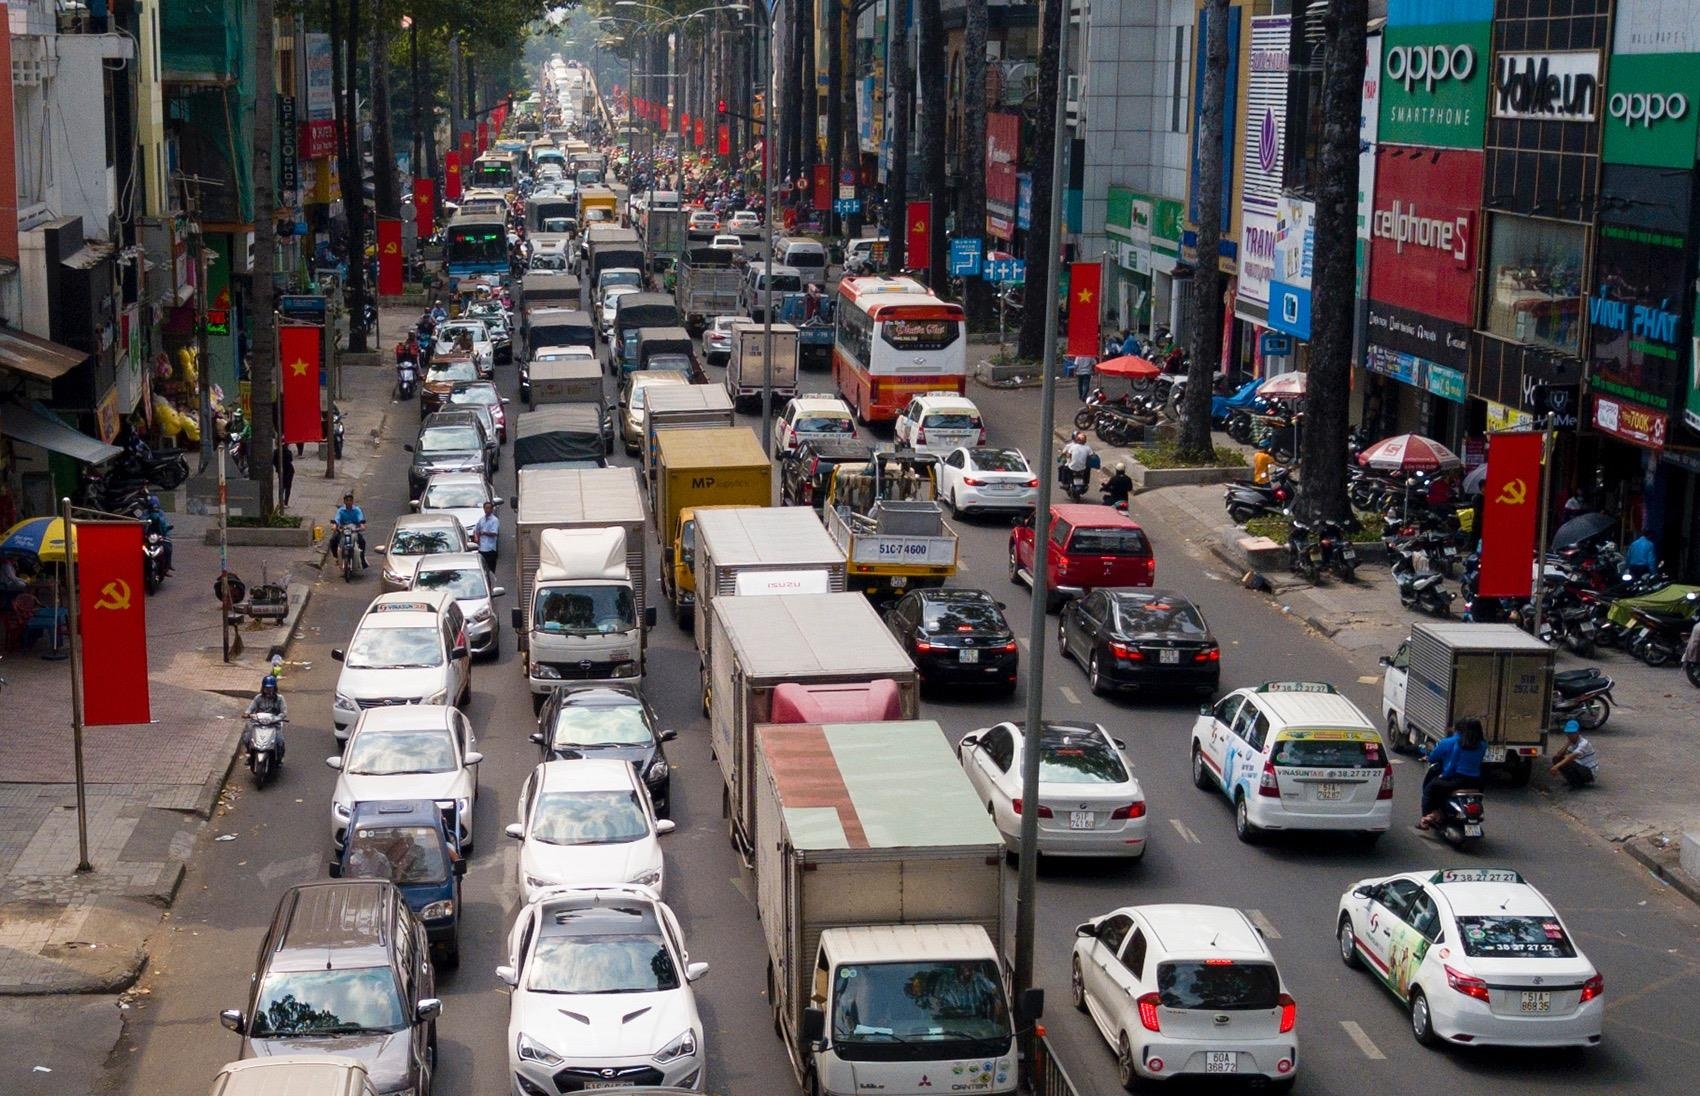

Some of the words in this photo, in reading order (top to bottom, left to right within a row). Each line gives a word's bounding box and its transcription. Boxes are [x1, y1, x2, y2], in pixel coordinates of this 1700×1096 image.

[1391, 106, 1470, 126] SMARTPHONE
[692, 477, 715, 488] MP
[1503, 873, 1515, 881] 27
[1213, 1052, 1230, 1063] 60A
